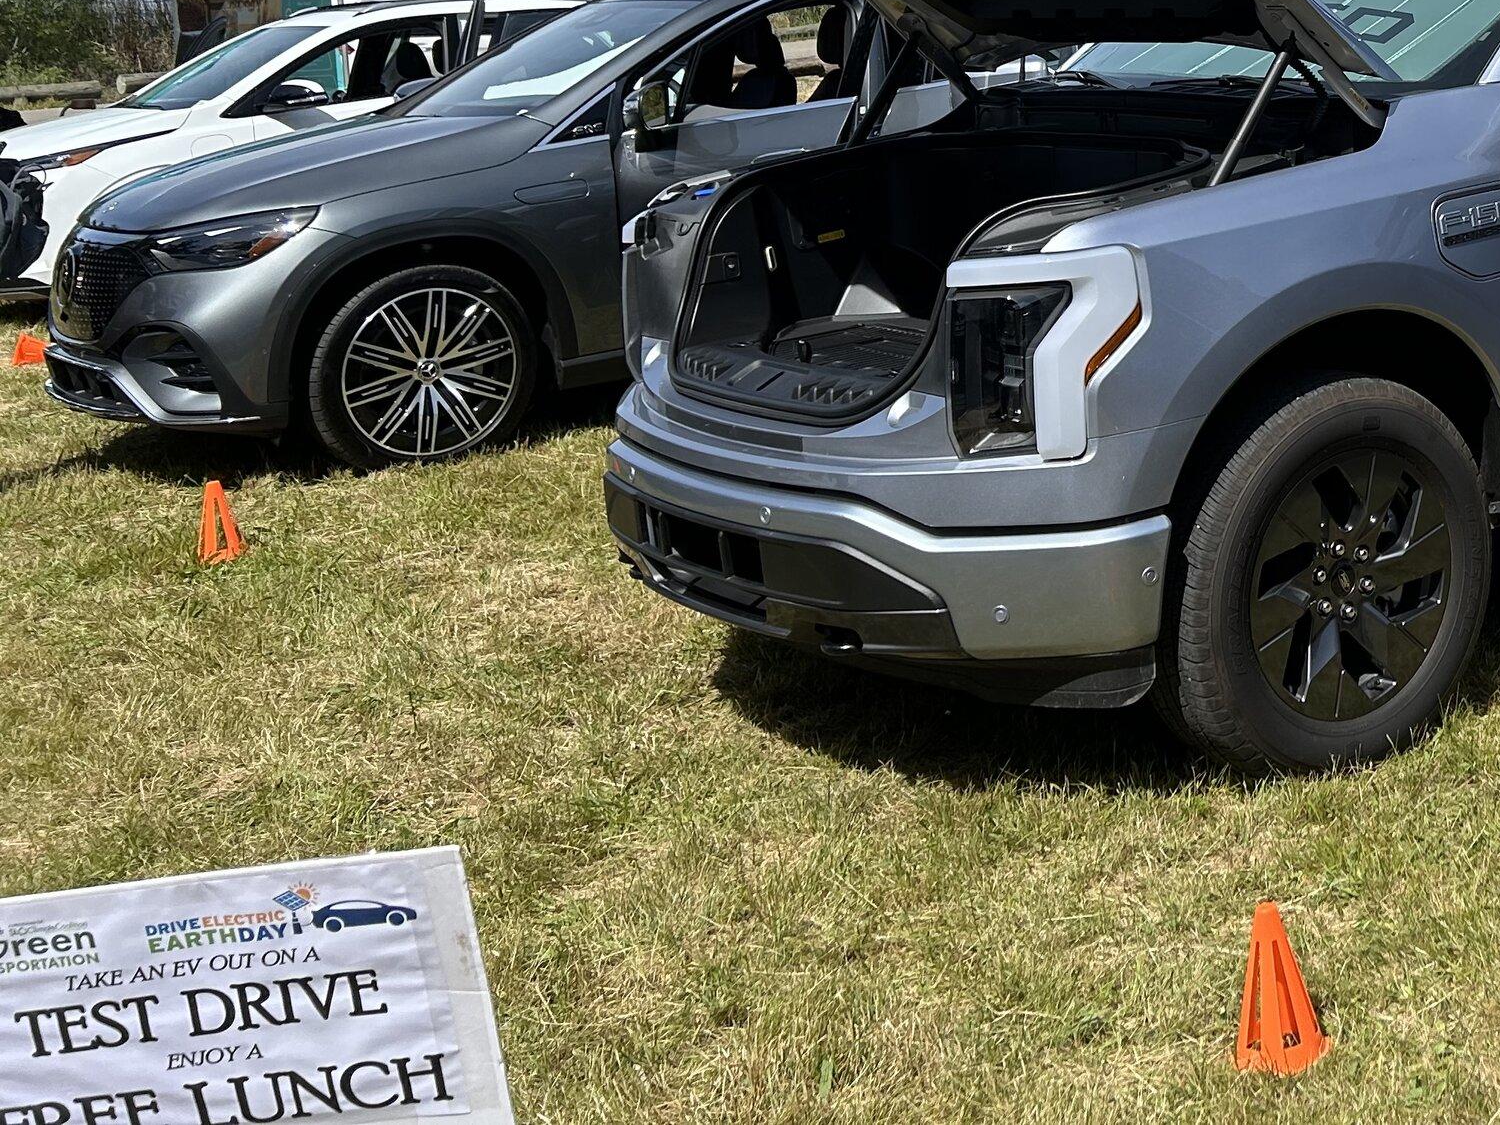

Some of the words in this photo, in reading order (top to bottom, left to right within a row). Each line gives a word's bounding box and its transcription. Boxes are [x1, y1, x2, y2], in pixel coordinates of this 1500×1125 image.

[145, 918, 201, 936] DRIVE
[202, 910, 286, 928] ELECTRIC
[147, 928, 237, 953] EARTH
[238, 922, 288, 942] DAY
[65, 970, 123, 991] TAKE
[130, 963, 165, 984] AN
[172, 957, 203, 977] EV
[209, 953, 255, 971] OUT
[261, 948, 297, 967] ON
[302, 946, 321, 963] A
[14, 995, 160, 1057] TEST
[180, 969, 388, 1037] DRIVE
[166, 1045, 240, 1071] ENJOY
[246, 1043, 264, 1060] A
[183, 1053, 454, 1125] LUNCH
